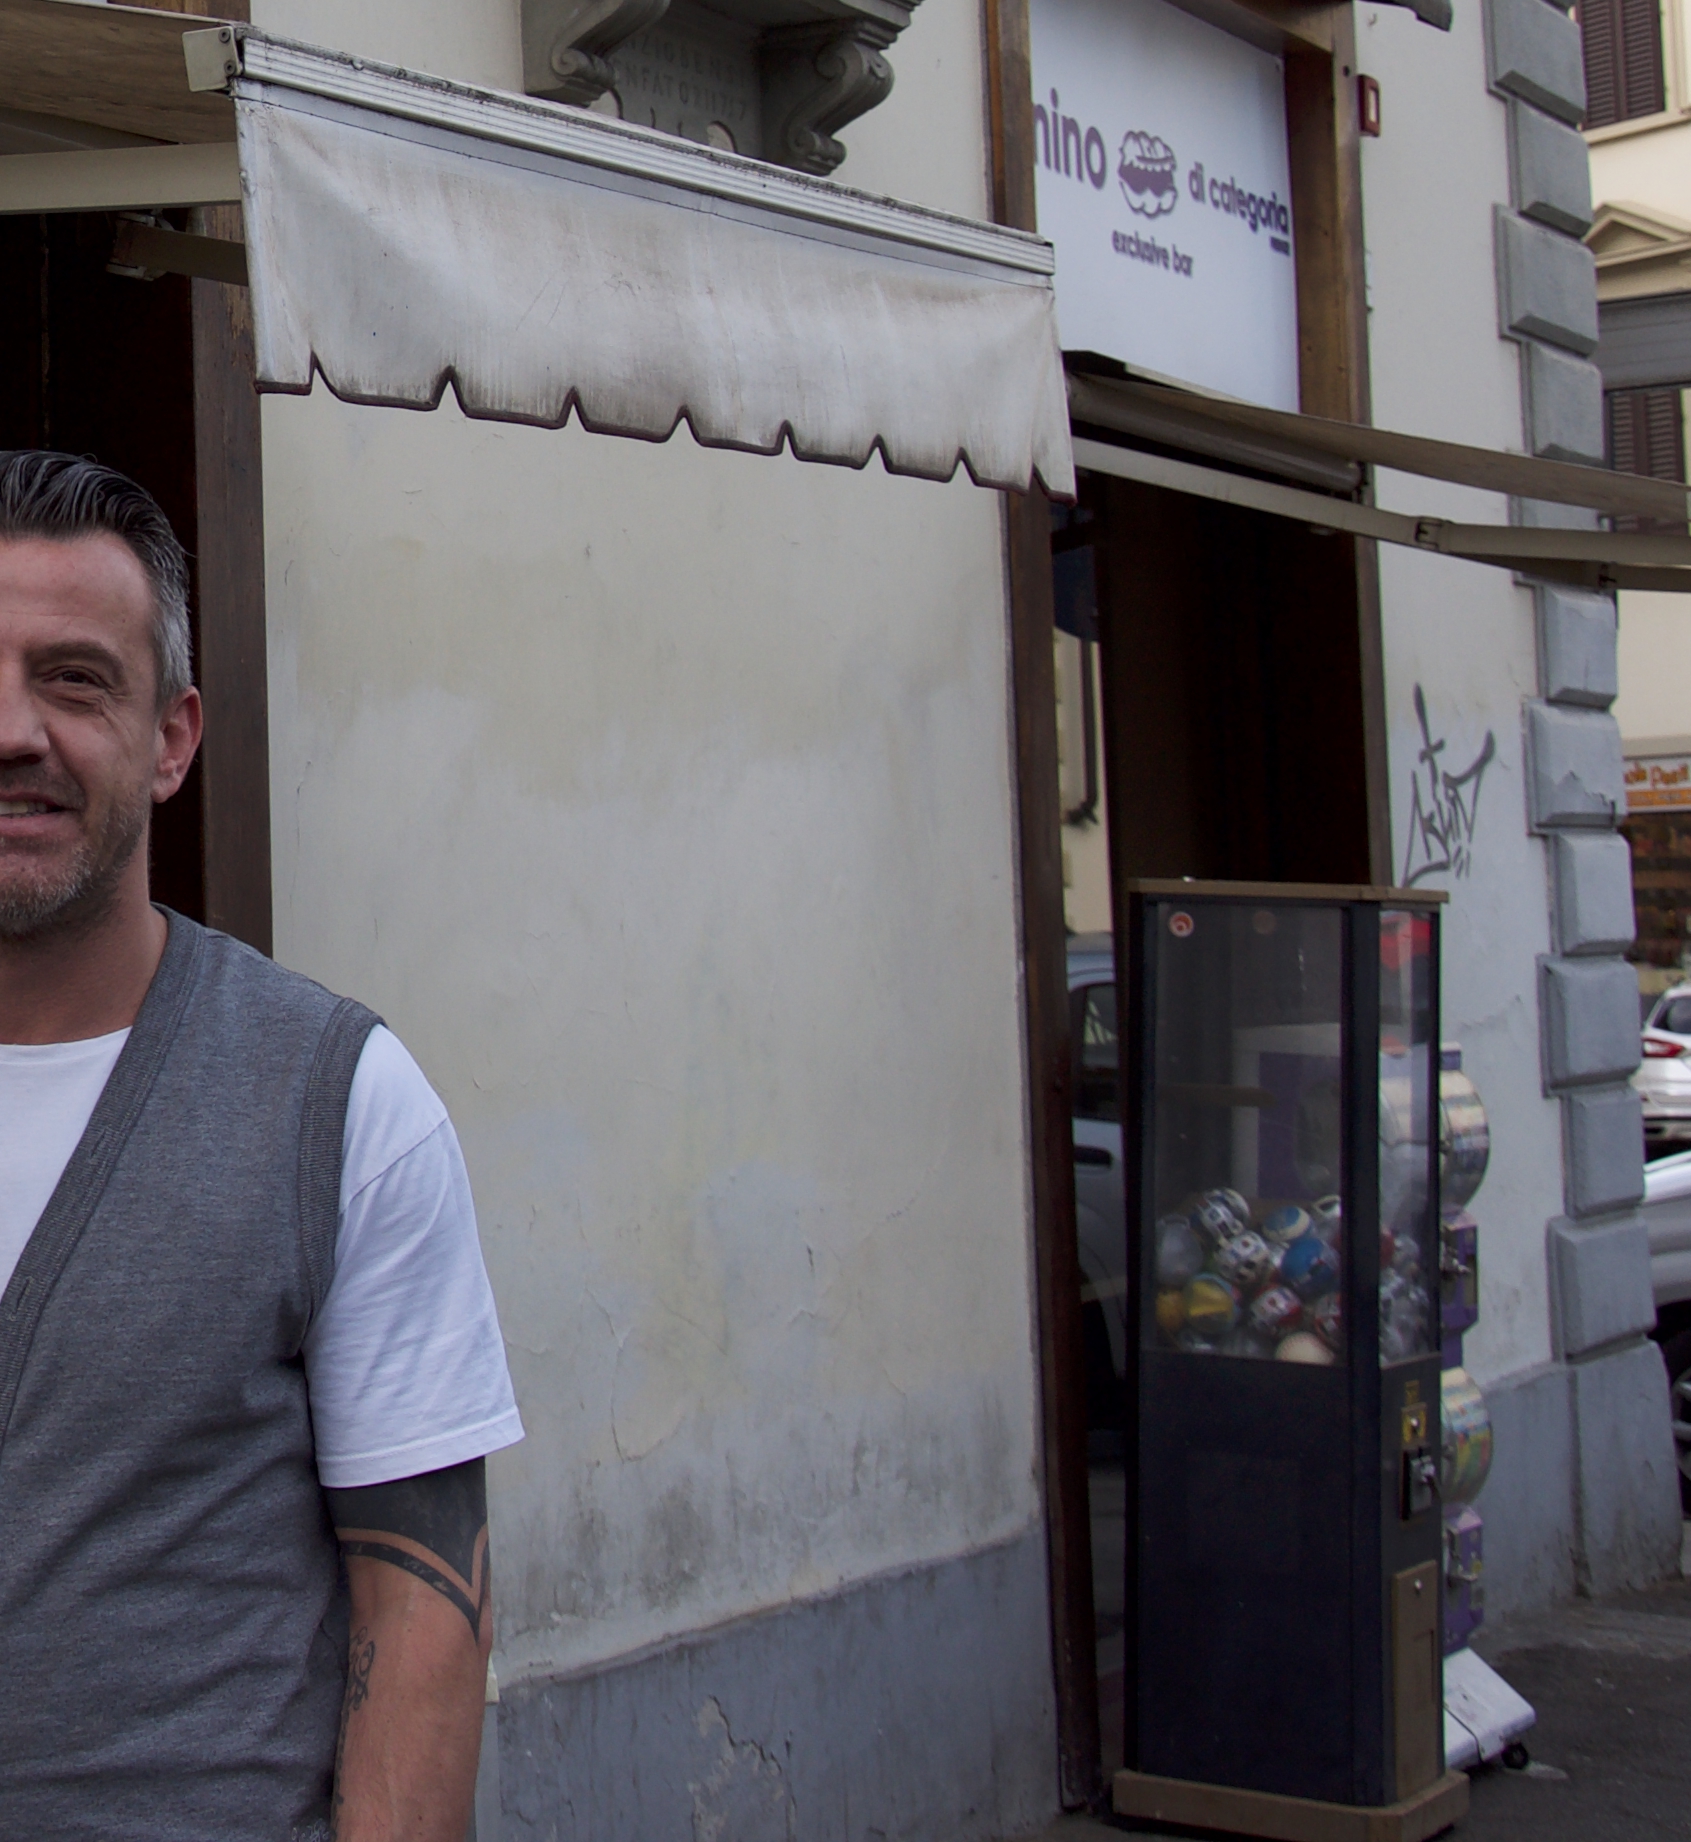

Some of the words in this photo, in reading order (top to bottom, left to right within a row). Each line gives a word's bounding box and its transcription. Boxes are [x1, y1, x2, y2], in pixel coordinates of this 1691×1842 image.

[1188, 160, 1206, 204] di
[1209, 175, 1290, 235] categoria
[1111, 229, 1170, 271] exclusive
[1172, 243, 1195, 279] bar
